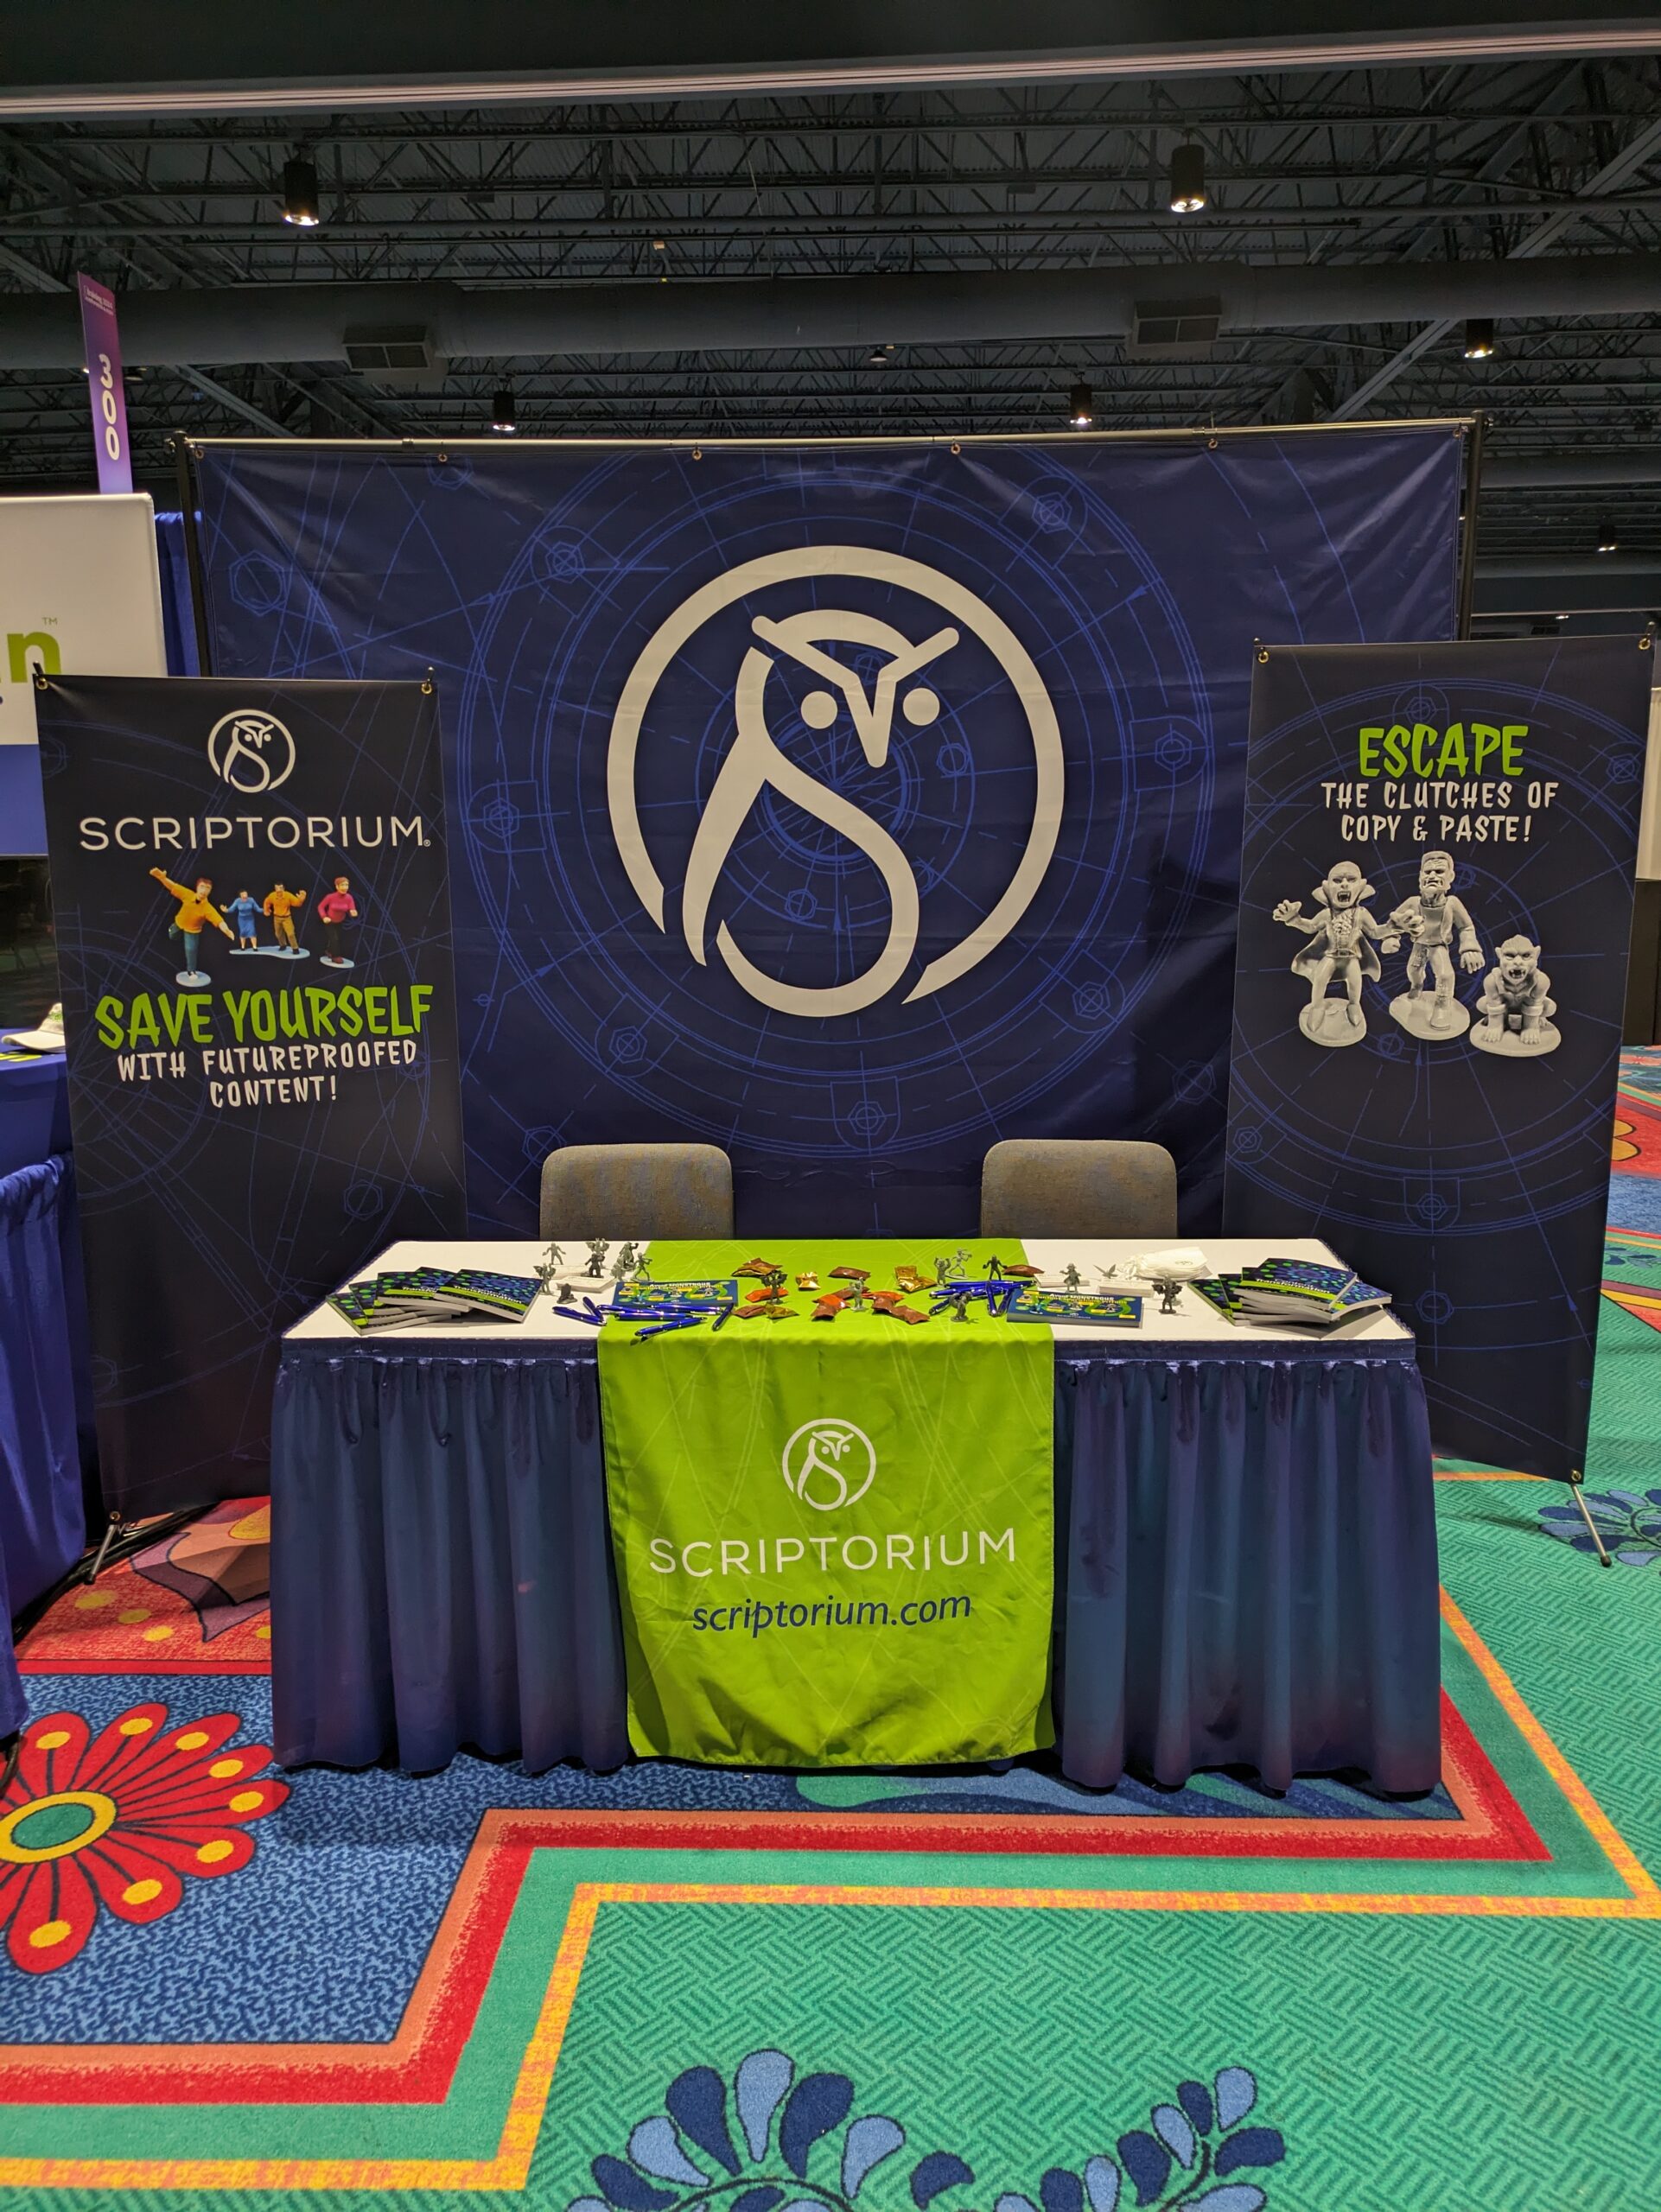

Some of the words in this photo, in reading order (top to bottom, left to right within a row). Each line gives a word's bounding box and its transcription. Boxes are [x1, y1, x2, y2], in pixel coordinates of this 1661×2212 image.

[99, 353, 120, 461] 300
[1359, 722, 1529, 779] ESCAPE
[1321, 782, 1368, 809] THE
[1384, 781, 1512, 810] CLUTCHES
[1527, 781, 1559, 809] OF
[1341, 815, 1402, 842] COPY
[1412, 815, 1429, 842] &
[1439, 815, 1531, 842] PASTE!
[94, 993, 213, 1050] SAVE
[222, 984, 434, 1044] YOURSELF
[117, 1051, 187, 1082] WITH
[203, 1039, 417, 1077] FUTUREPROOFED
[210, 1076, 337, 1109] CONTENT!
[649, 1528, 1015, 1578] SCRIPTORIUM
[692, 1595, 971, 1638] scriptorium.com
